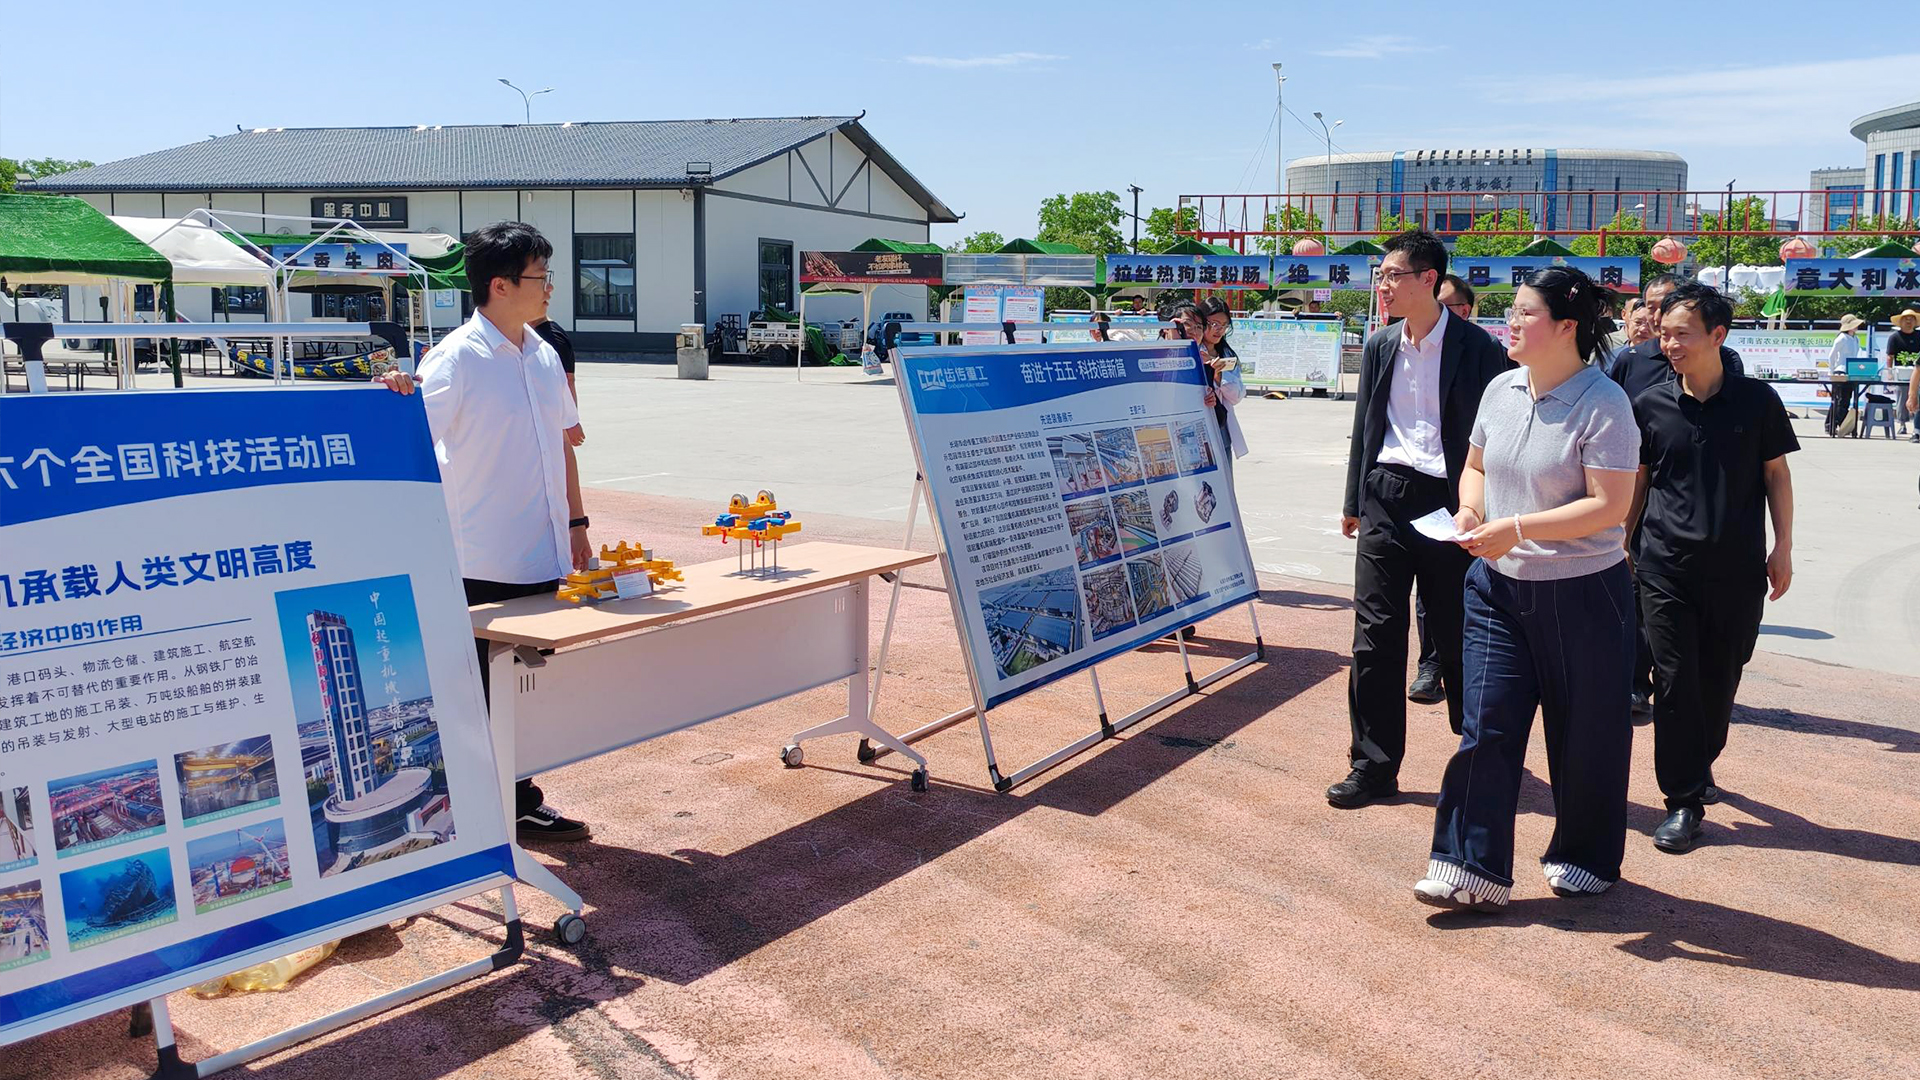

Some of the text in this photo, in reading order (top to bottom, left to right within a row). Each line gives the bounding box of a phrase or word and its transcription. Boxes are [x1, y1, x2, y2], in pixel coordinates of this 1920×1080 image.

[324, 202, 390, 218] 服务中心
[1114, 264, 1261, 284] 拉丝热狗淀粉肠
[1288, 264, 1381, 285] 绝味
[1468, 265, 1623, 287] 巴西肉
[1796, 267, 1920, 290] 意大利冰
[943, 366, 988, 382] 齿传重工
[1020, 358, 1127, 384] 奋进十五五·科技谱新篇
[0, 615, 143, 650] 经济中的作用
[7, 635, 256, 686] 港口码头、物流仓储、建筑施工、航空航
[0, 673, 262, 731] 建筑工地的施工吊装、万吨级船舶的拼装建
[1, 693, 265, 753] 的吊装与发射、大型电站的施工与维护、生
